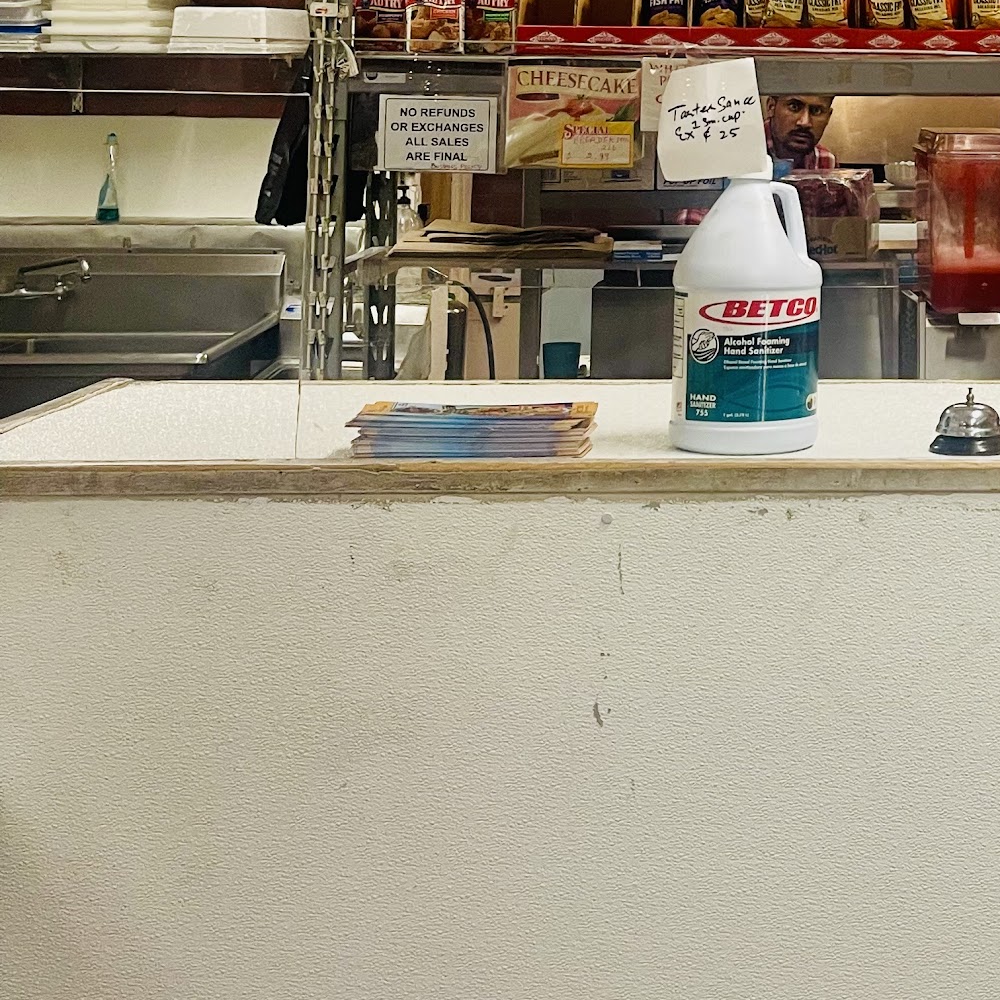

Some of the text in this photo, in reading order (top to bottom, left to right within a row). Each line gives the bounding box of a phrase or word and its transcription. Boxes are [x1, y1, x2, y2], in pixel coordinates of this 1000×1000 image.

[518, 71, 637, 94] CHEESECAKE
[400, 108, 476, 117] NO REFUNDS
[391, 122, 484, 132] OR EXCHANGES
[406, 138, 469, 146] ALL SALES
[406, 152, 467, 161] ARE FINAL
[722, 297, 817, 318] BETCO
[724, 337, 790, 346] Alcohol Foaming
[724, 346, 783, 355] Hand Sanitizer
[690, 401, 716, 409] SANITIZER
